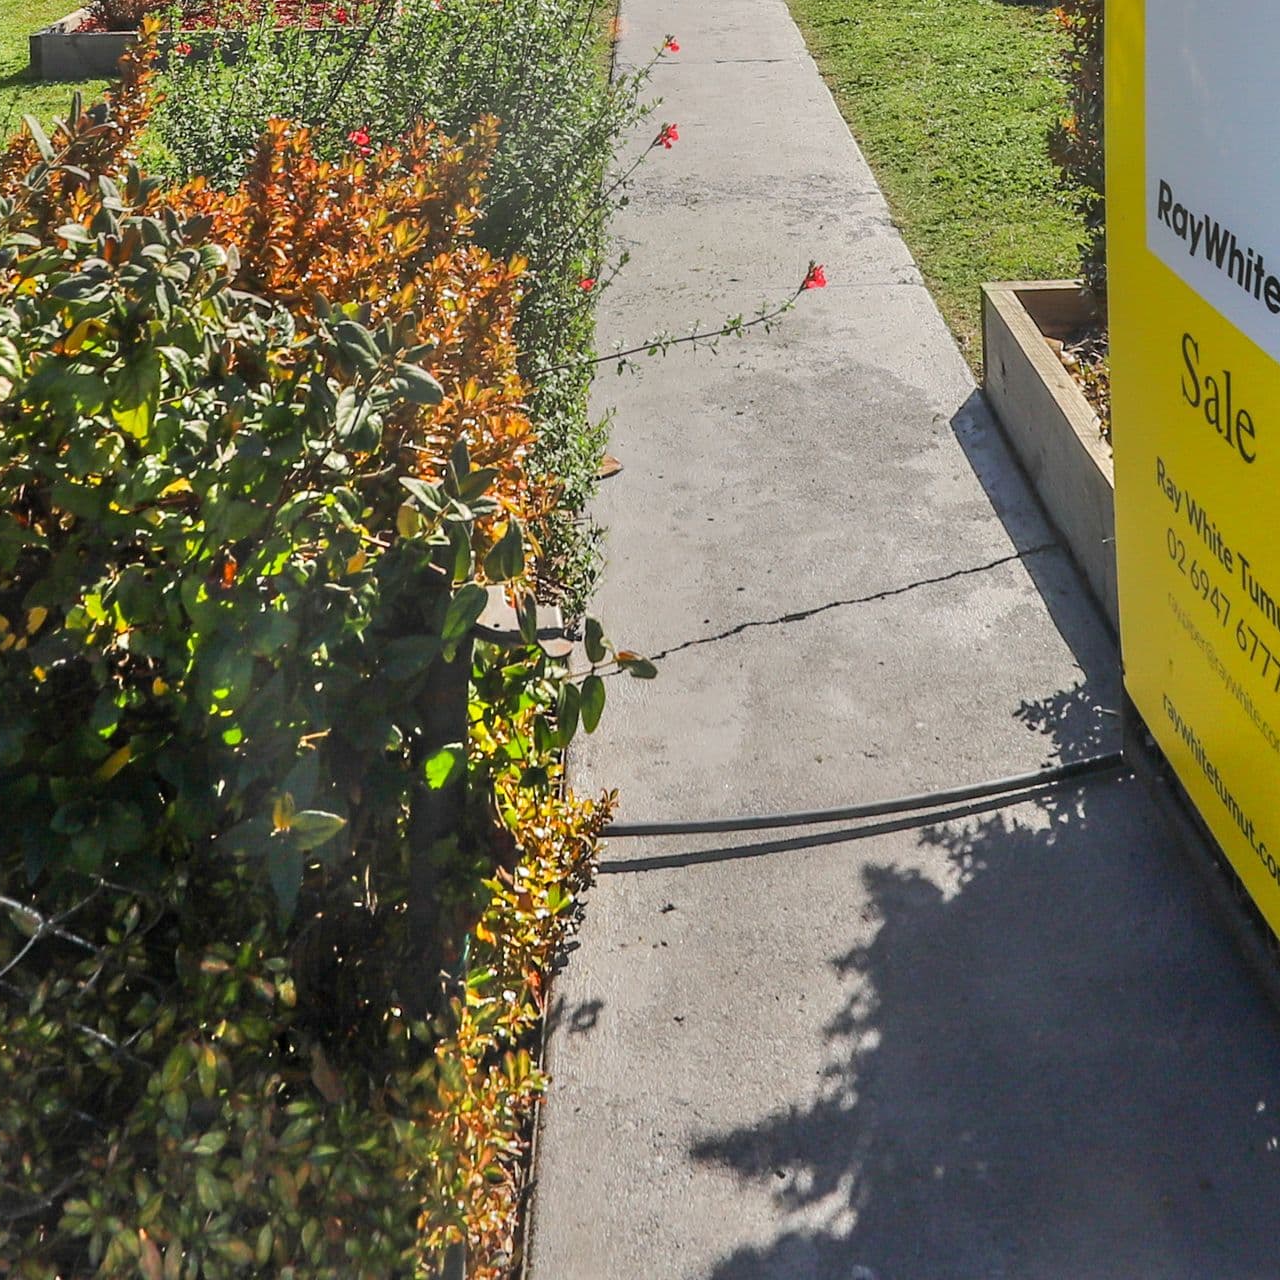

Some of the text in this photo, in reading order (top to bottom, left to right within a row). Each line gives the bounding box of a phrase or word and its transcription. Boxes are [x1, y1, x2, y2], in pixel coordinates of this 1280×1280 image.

[1181, 332, 1256, 464] Sale
[1157, 456, 1182, 513] Ray
[1185, 490, 1233, 574] White
[1167, 528, 1186, 575] 02
[1190, 560, 1230, 627] 6947
